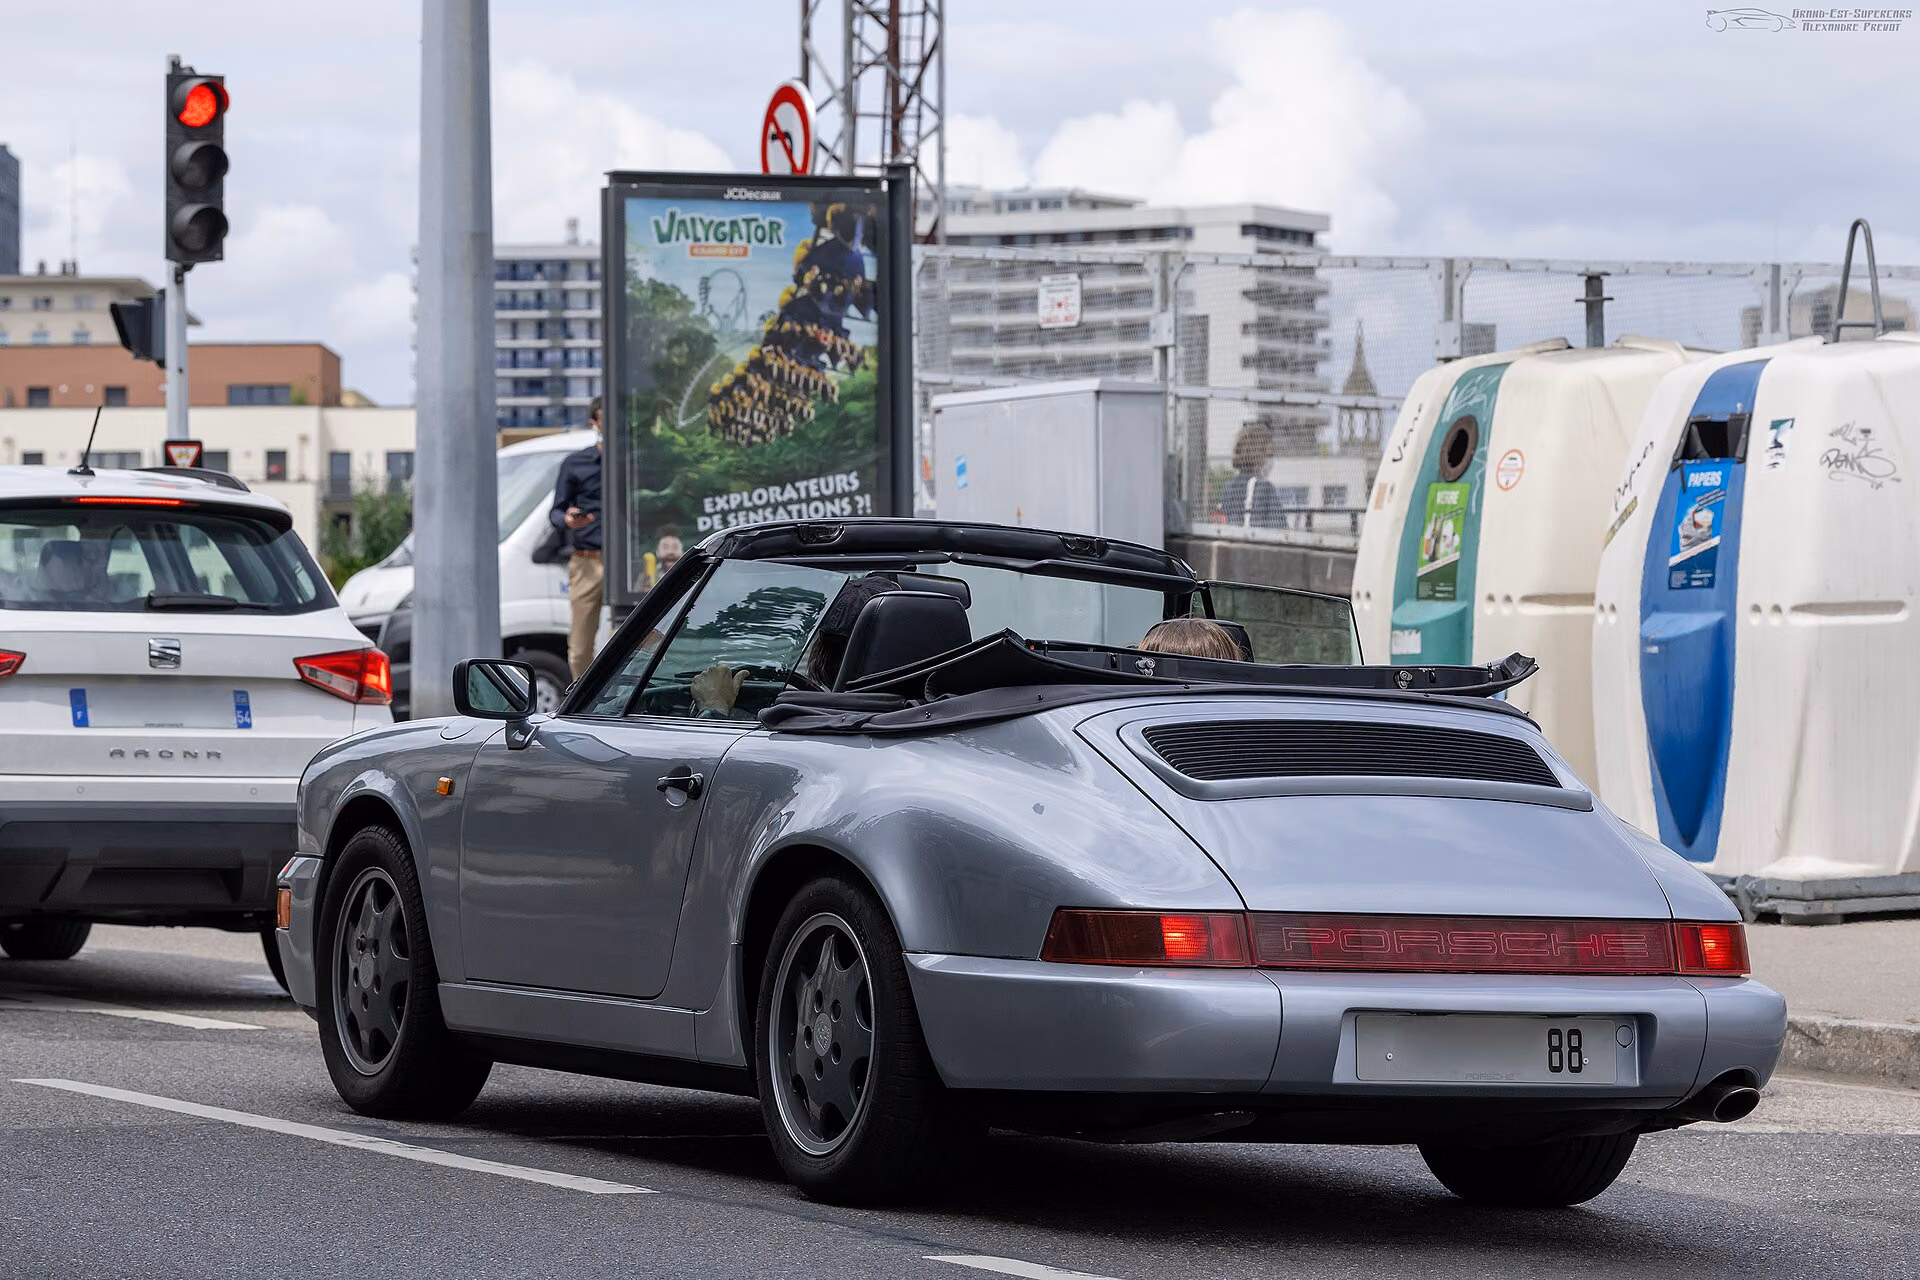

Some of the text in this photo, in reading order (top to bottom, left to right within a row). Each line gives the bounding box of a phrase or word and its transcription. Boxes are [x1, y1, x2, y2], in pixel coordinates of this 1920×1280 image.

[723, 187, 782, 200] JCDecaux
[653, 210, 783, 245] VALYGATOR
[703, 471, 861, 514] EXPLORATEURS
[1687, 471, 1722, 487] PAPIERS
[697, 494, 872, 532] DE SENSATIONS ?!
[237, 710, 251, 724] 54
[109, 749, 222, 759] ARONA
[1282, 926, 1650, 958] PORSCHE
[1547, 1028, 1583, 1073] 88
